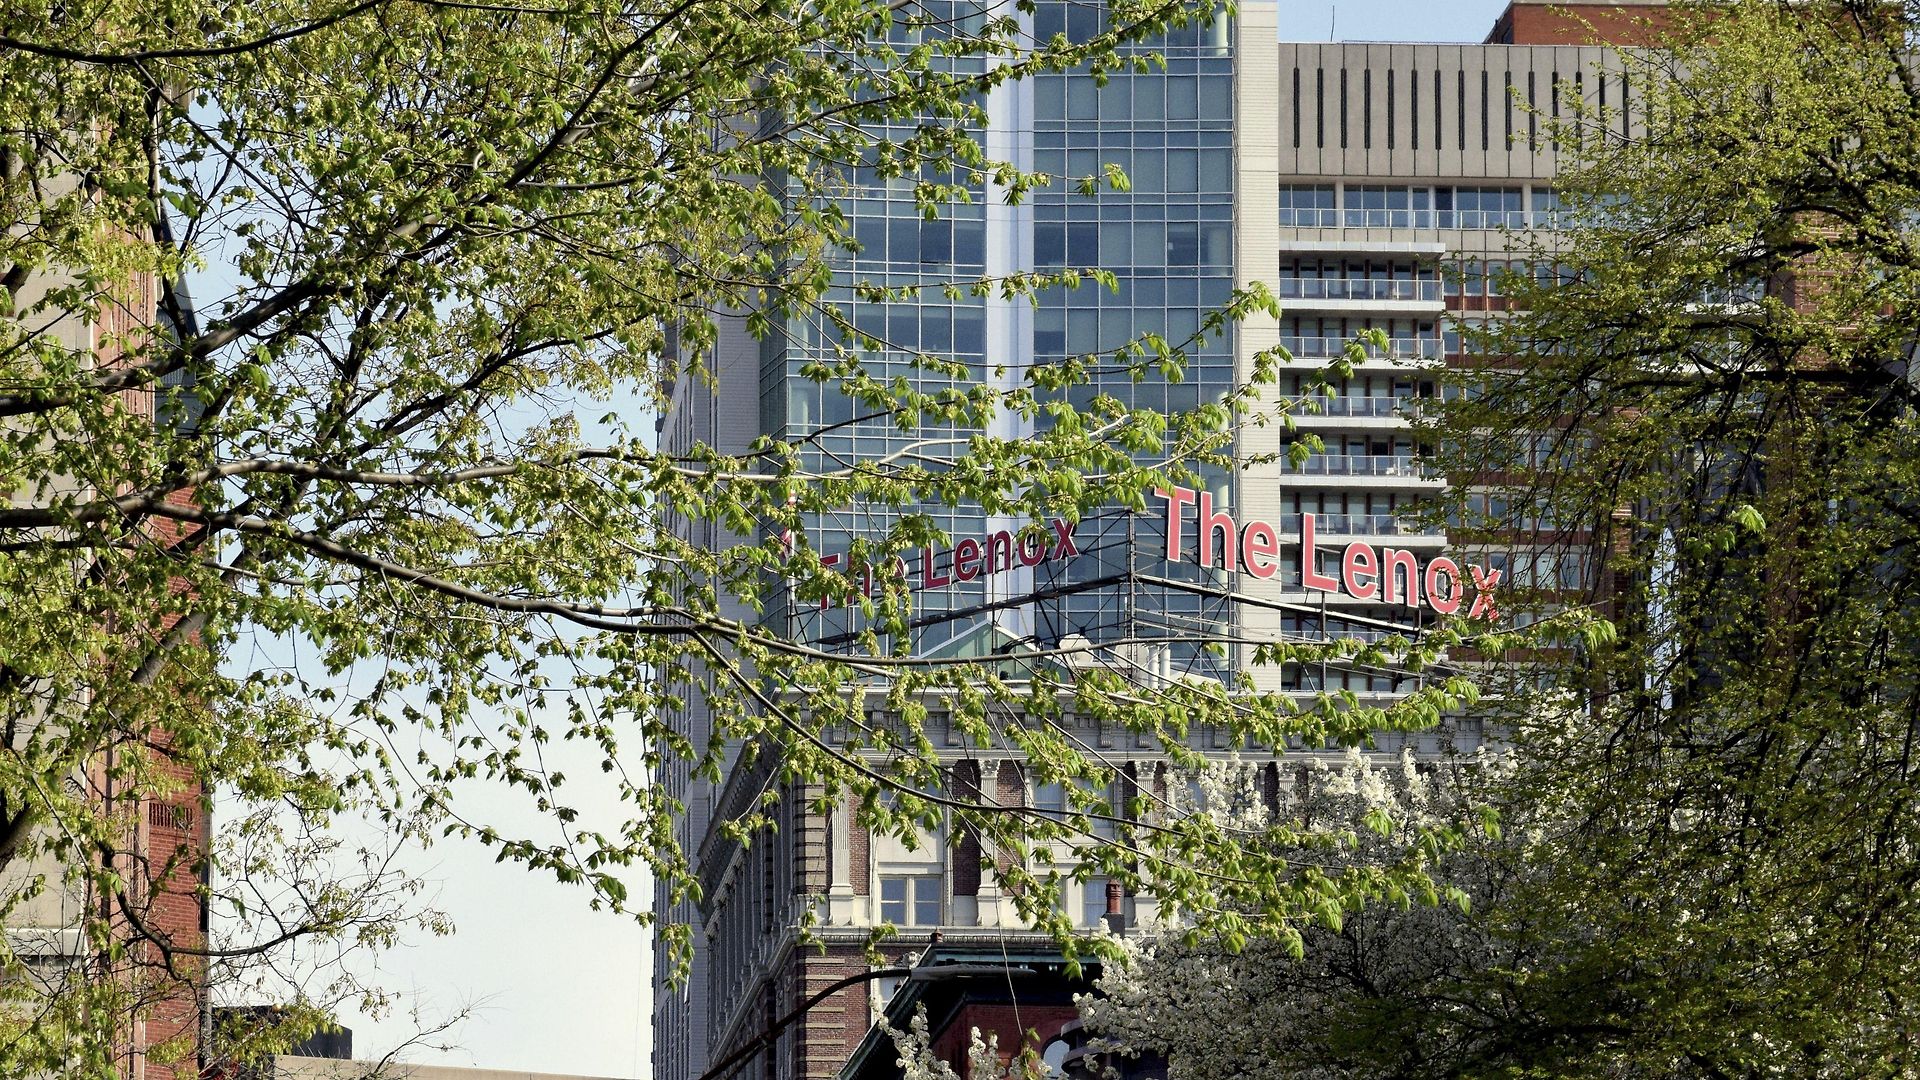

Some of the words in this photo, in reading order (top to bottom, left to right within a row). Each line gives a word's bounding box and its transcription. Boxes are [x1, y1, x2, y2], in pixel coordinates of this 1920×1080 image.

[923, 518, 1080, 590] Lenox
[1154, 485, 1280, 580] The
[1303, 512, 1503, 622] Lenox
